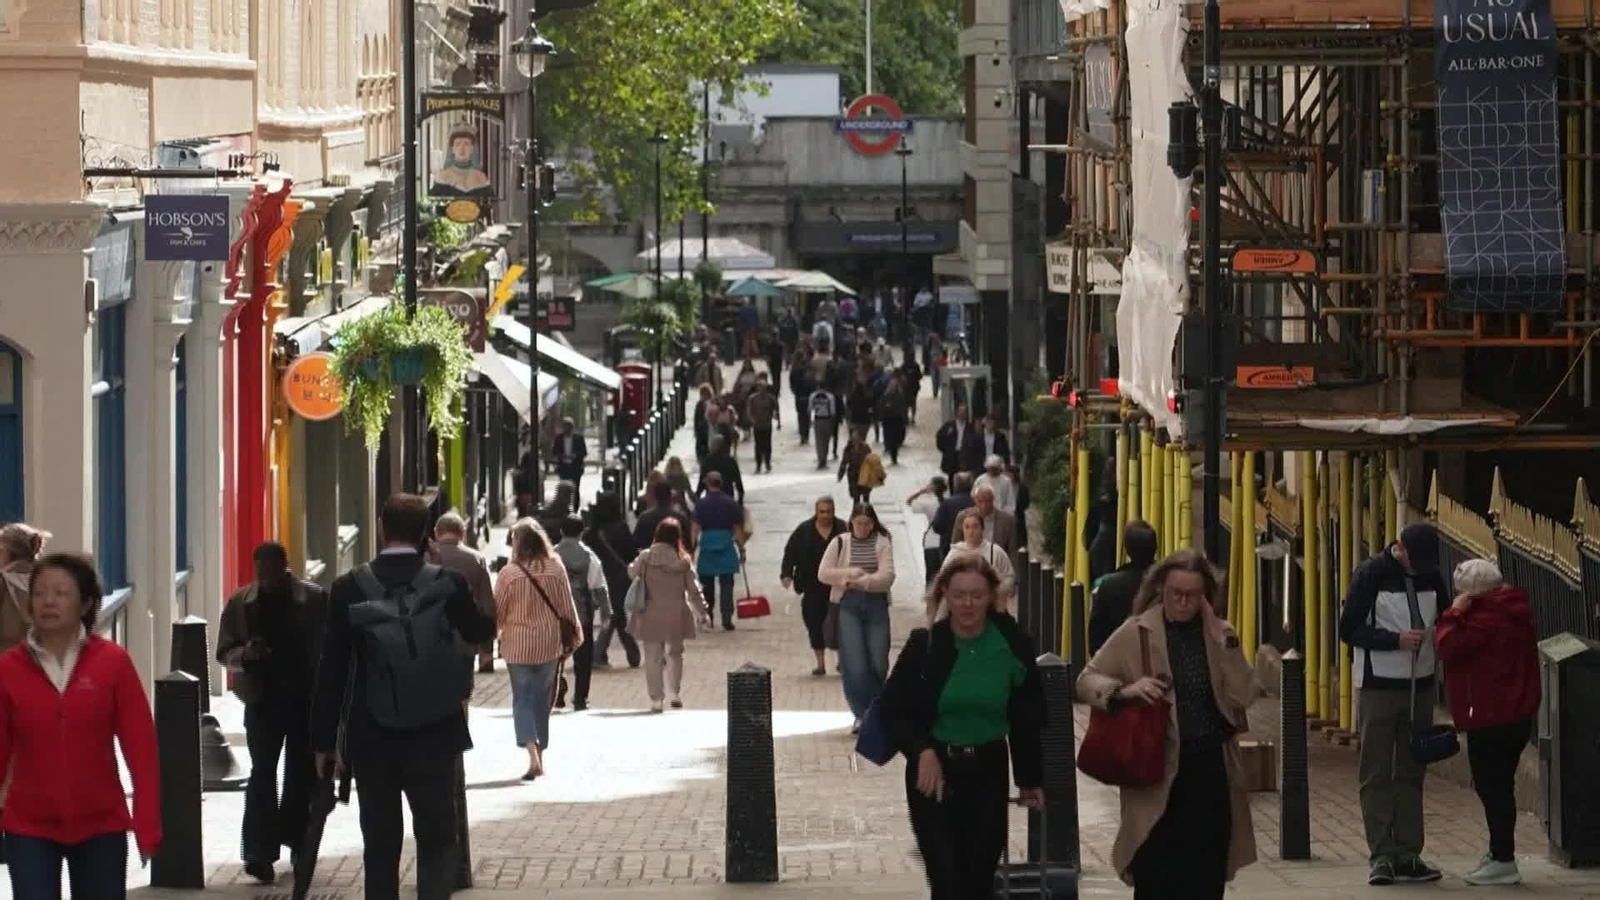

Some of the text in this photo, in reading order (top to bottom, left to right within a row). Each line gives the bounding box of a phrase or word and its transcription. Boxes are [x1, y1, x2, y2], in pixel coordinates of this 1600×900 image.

[1443, 12, 1549, 43] USUAL
[472, 97, 500, 111] WALES
[840, 120, 908, 129] UNDERGROUND
[148, 212, 226, 226] HOBSON'S
